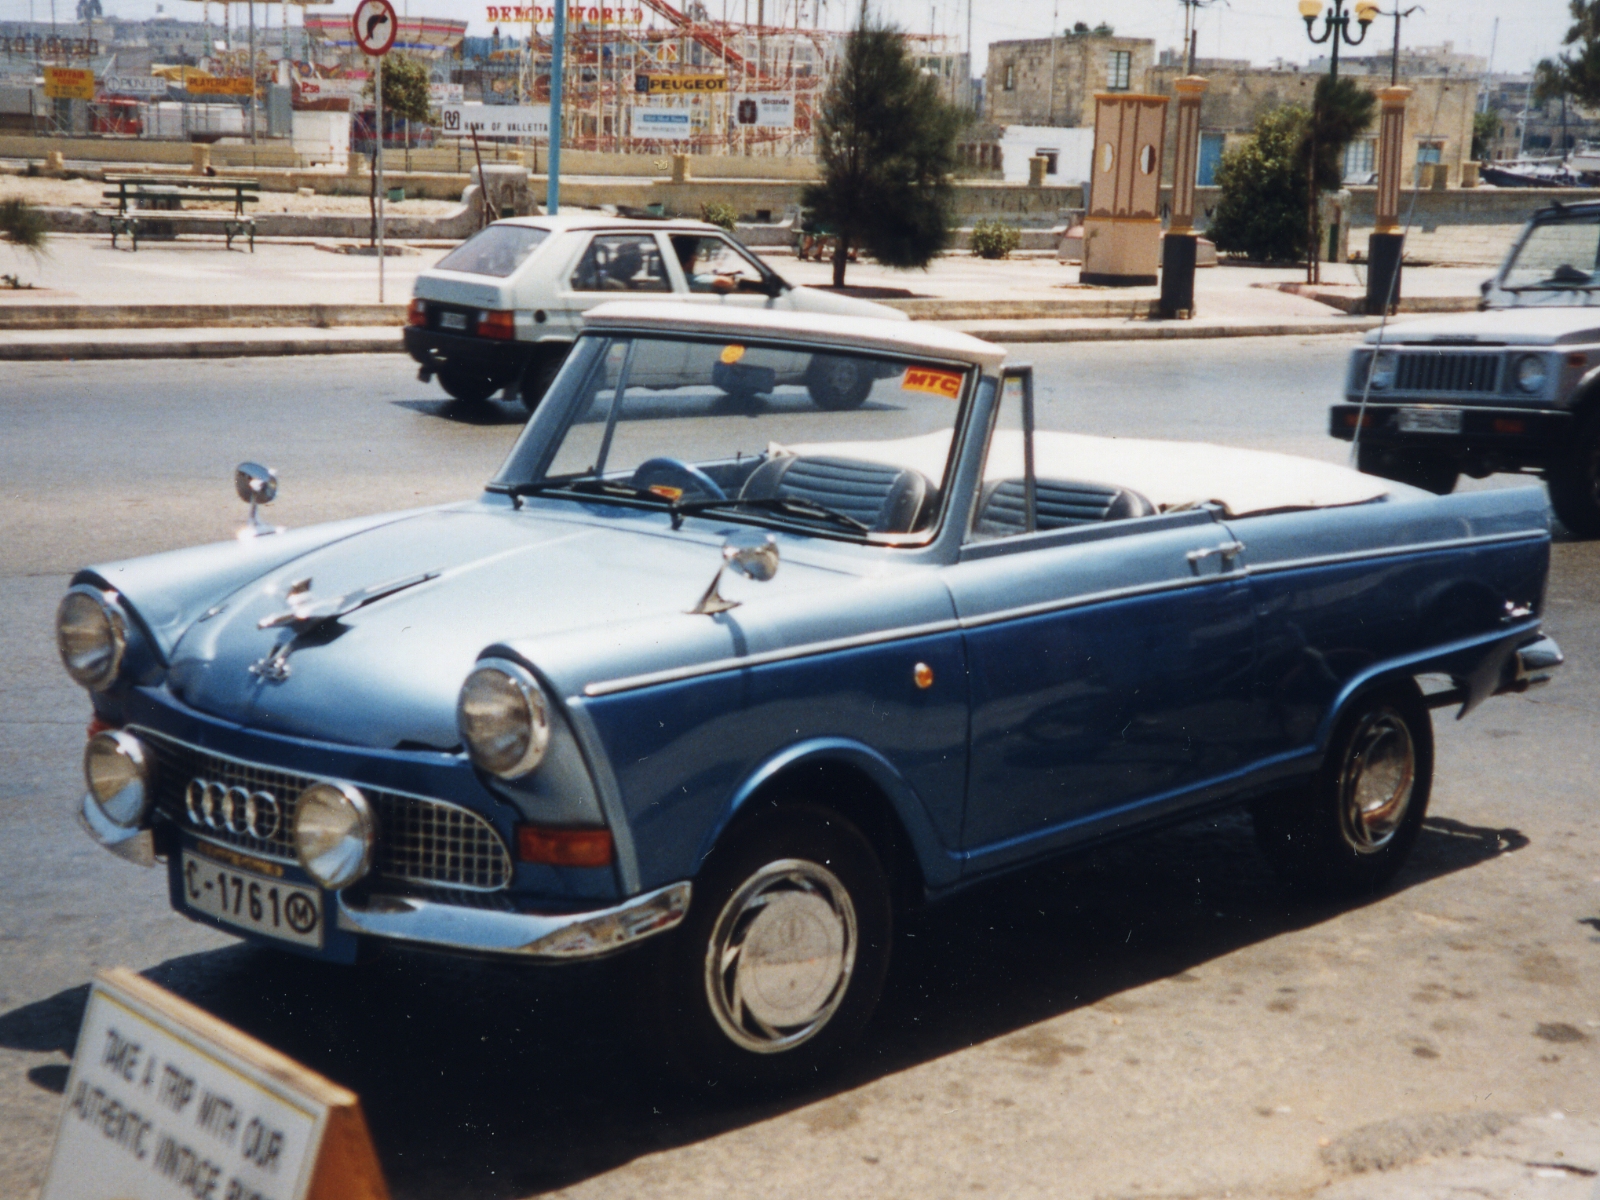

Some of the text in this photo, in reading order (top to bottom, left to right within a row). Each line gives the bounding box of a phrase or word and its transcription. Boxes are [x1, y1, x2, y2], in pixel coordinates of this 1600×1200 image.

[486, 6, 643, 25] DEMON WORLD
[650, 79, 725, 90] PEUGEOT
[491, 123, 501, 131] OF
[507, 123, 548, 131] VALLETTA
[906, 373, 959, 391] MTC
[187, 860, 280, 927] C-1761
[105, 1028, 284, 1174] TAKE A TRIP WITH OUR
[73, 1079, 221, 1200] AUTHENTIC VINTAGE
